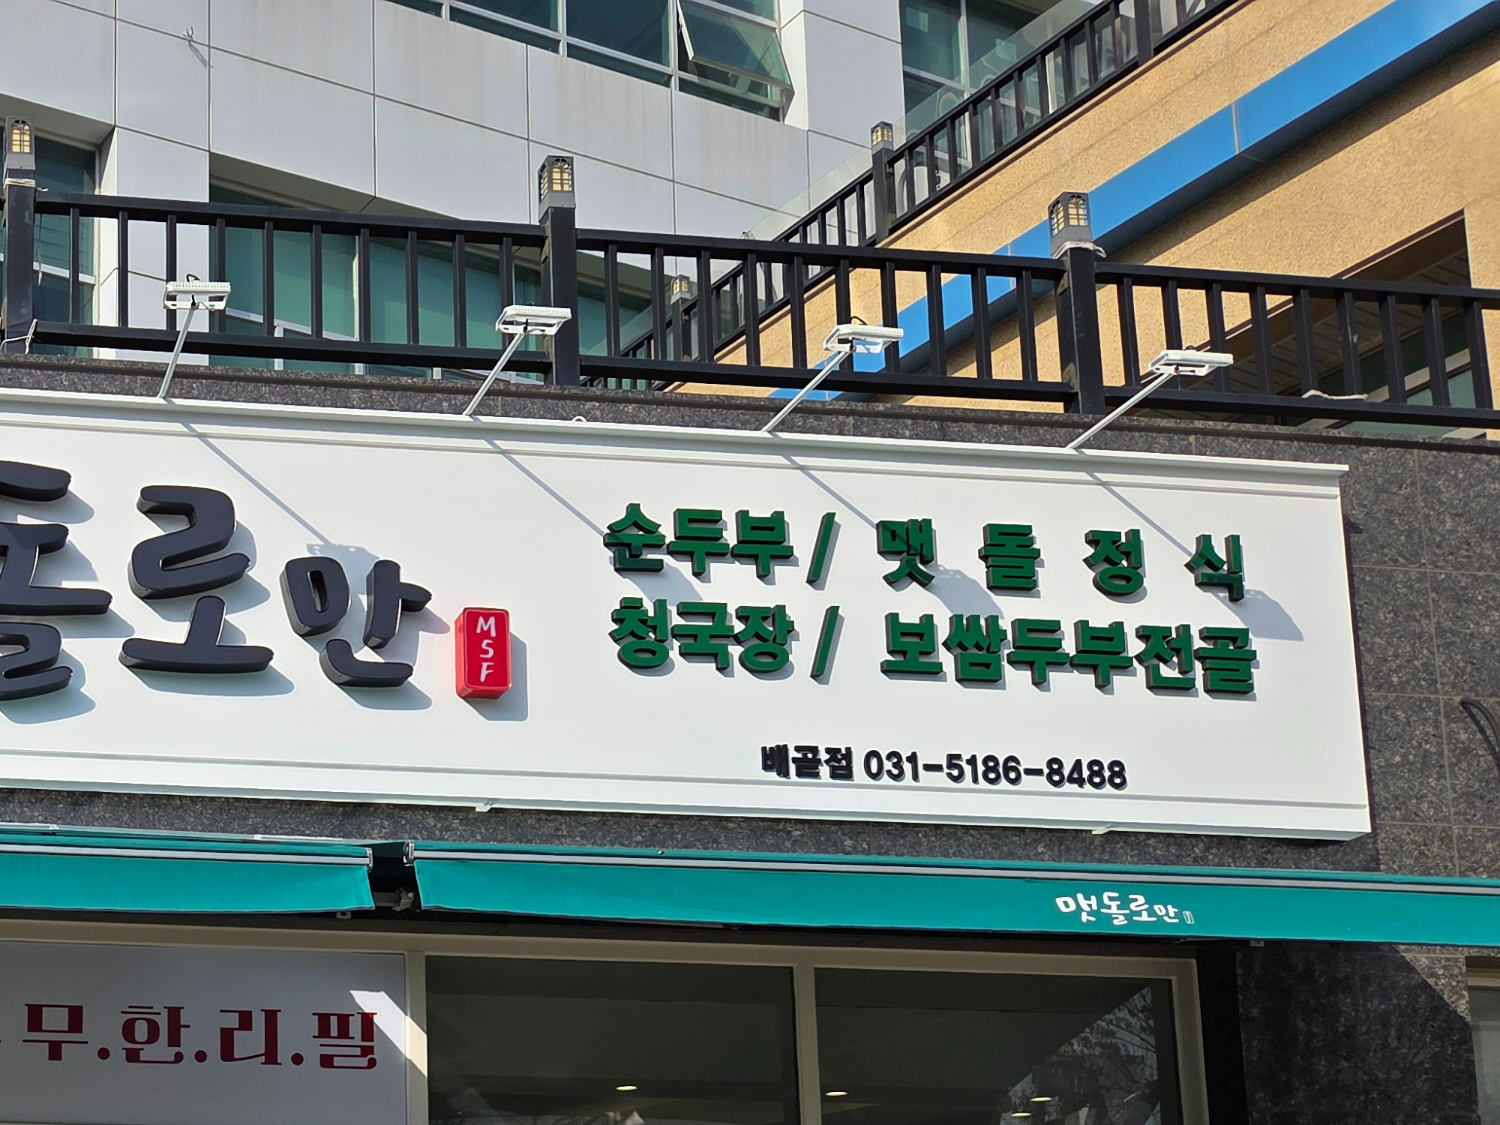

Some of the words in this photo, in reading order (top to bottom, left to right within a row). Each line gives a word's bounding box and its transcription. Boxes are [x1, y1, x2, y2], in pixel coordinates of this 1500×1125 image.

[475, 615, 497, 683] MSF
[880, 612, 1259, 696] 보쌈두부전골
[863, 749, 1129, 790] 031-5186-8488
[1055, 891, 1180, 926] 맷돌로만
